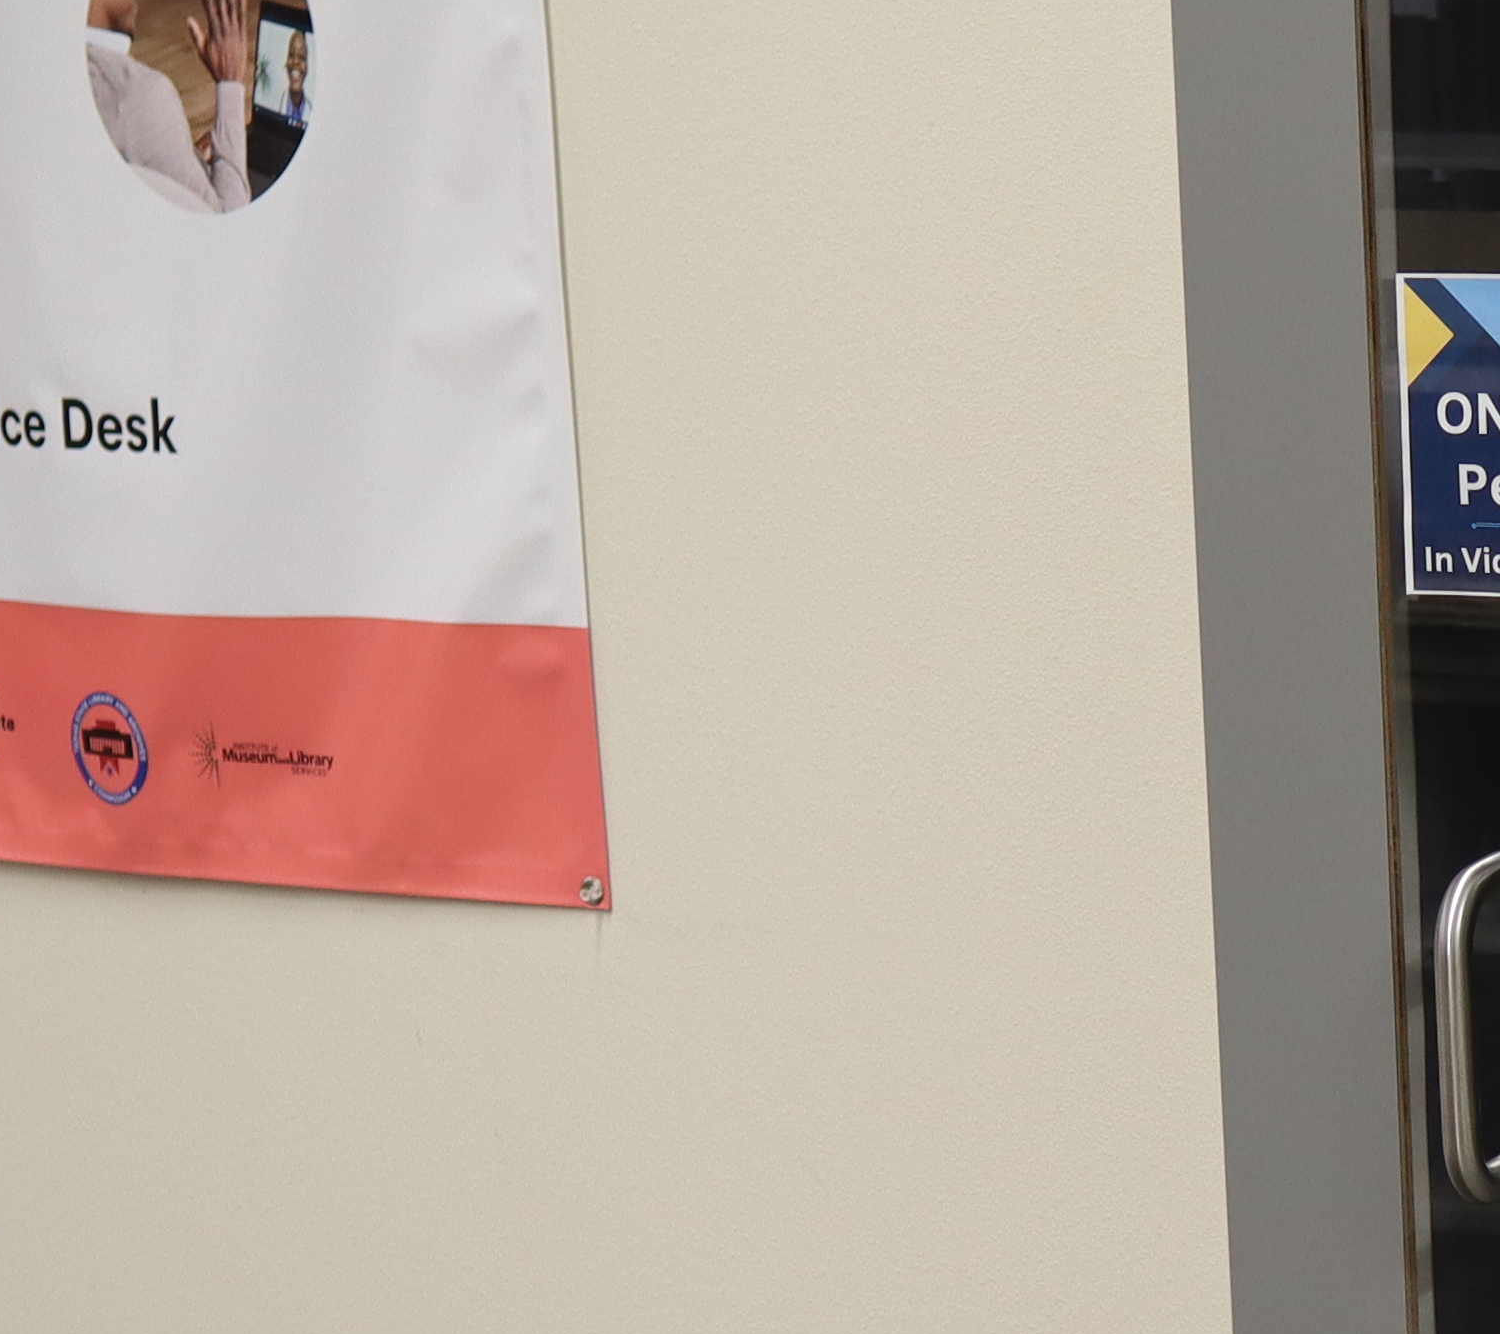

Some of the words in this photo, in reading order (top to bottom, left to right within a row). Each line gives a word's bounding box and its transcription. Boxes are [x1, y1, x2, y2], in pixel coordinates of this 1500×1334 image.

[60, 396, 178, 455] Desk
[1423, 545, 1453, 574] In
[222, 748, 277, 763] Museum
[289, 750, 334, 771] Library
